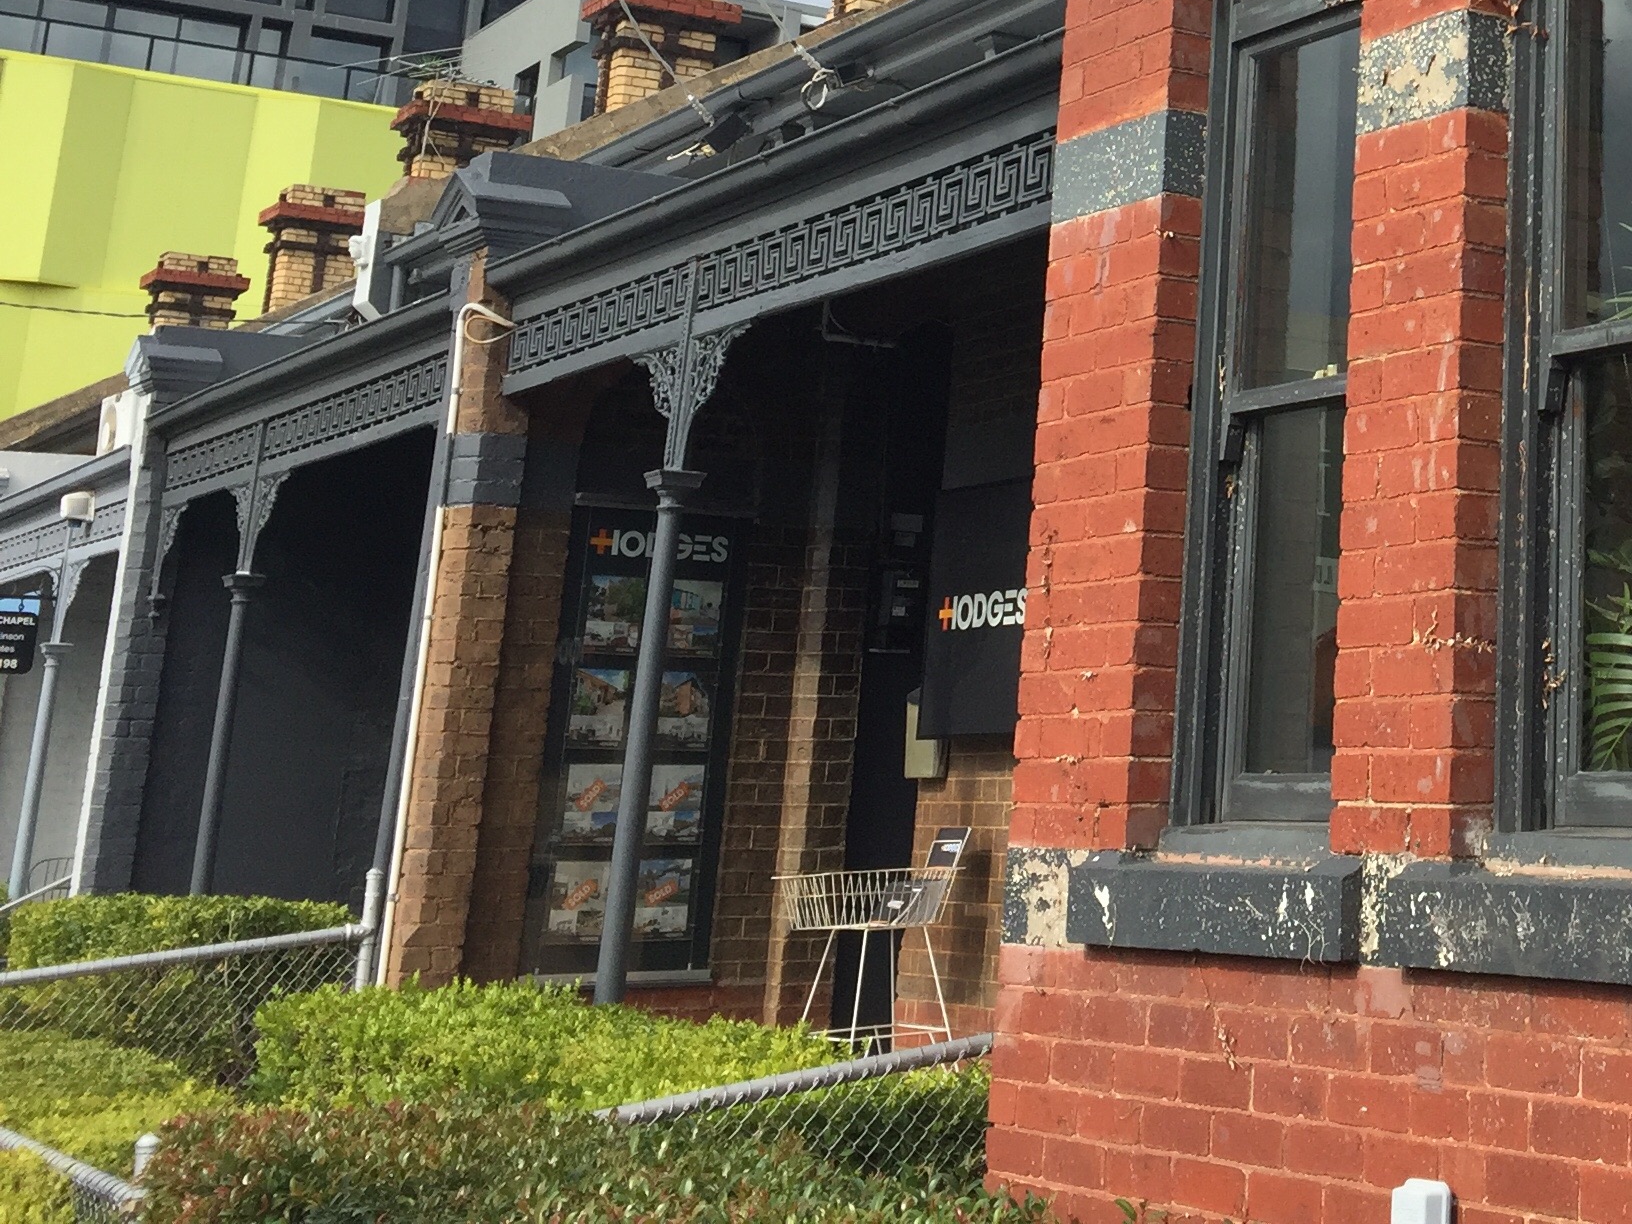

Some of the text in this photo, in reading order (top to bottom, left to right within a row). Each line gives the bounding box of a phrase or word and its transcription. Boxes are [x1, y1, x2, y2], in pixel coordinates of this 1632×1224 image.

[939, 588, 1028, 631] HODGES
[579, 784, 600, 808] SOLD
[662, 788, 685, 808] SOLD
[569, 884, 591, 907] SOLD
[648, 884, 672, 903] SOLD
